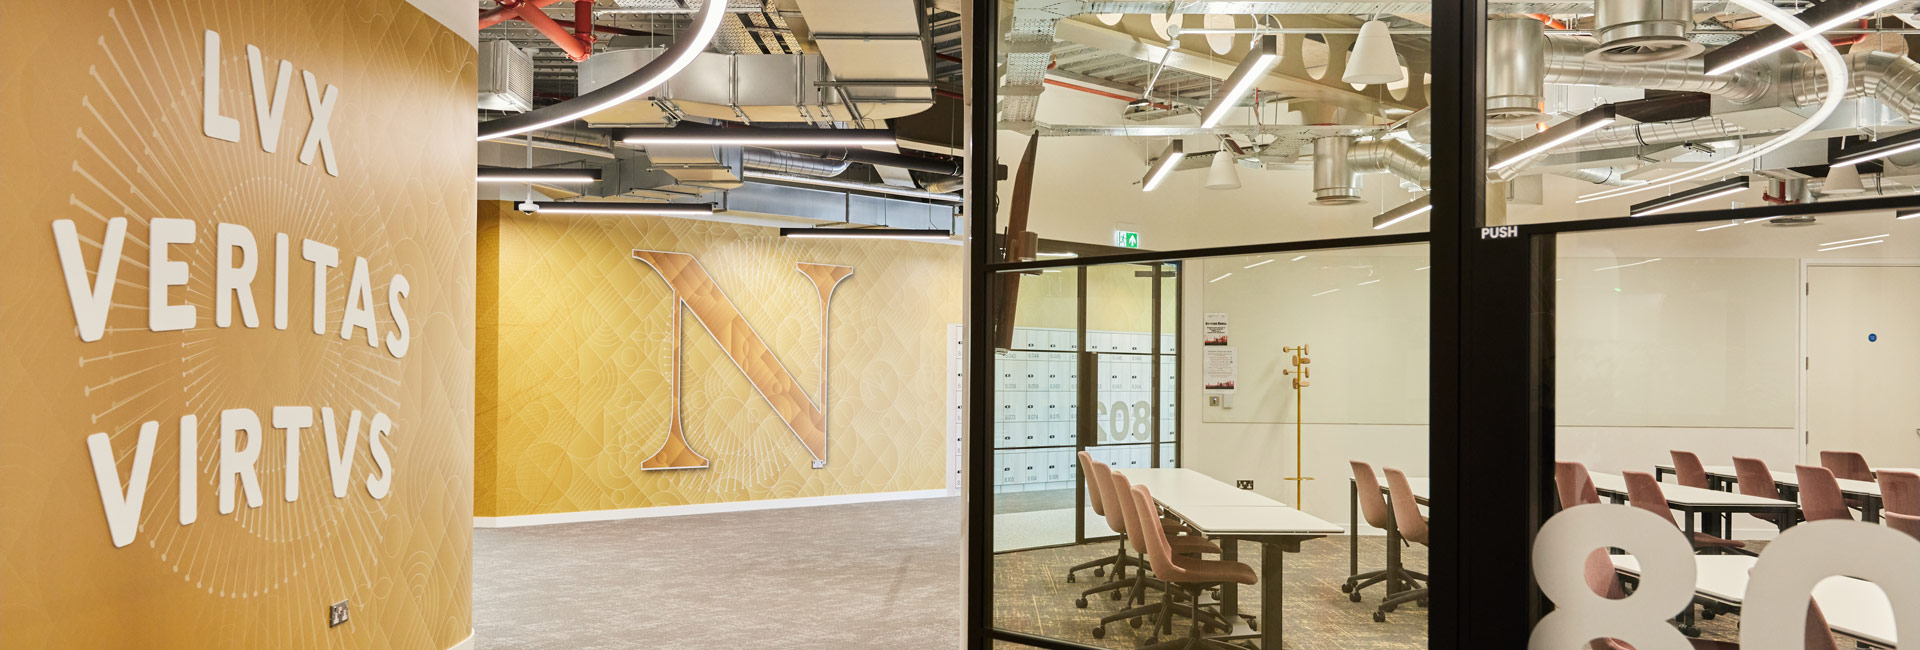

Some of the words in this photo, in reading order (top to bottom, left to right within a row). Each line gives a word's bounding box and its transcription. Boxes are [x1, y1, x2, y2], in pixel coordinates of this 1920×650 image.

[203, 29, 339, 177] LVX
[52, 217, 410, 359] VERITAS
[1481, 226, 1518, 239] PUSH
[632, 249, 854, 470] N
[87, 405, 392, 548] VIRTVS
